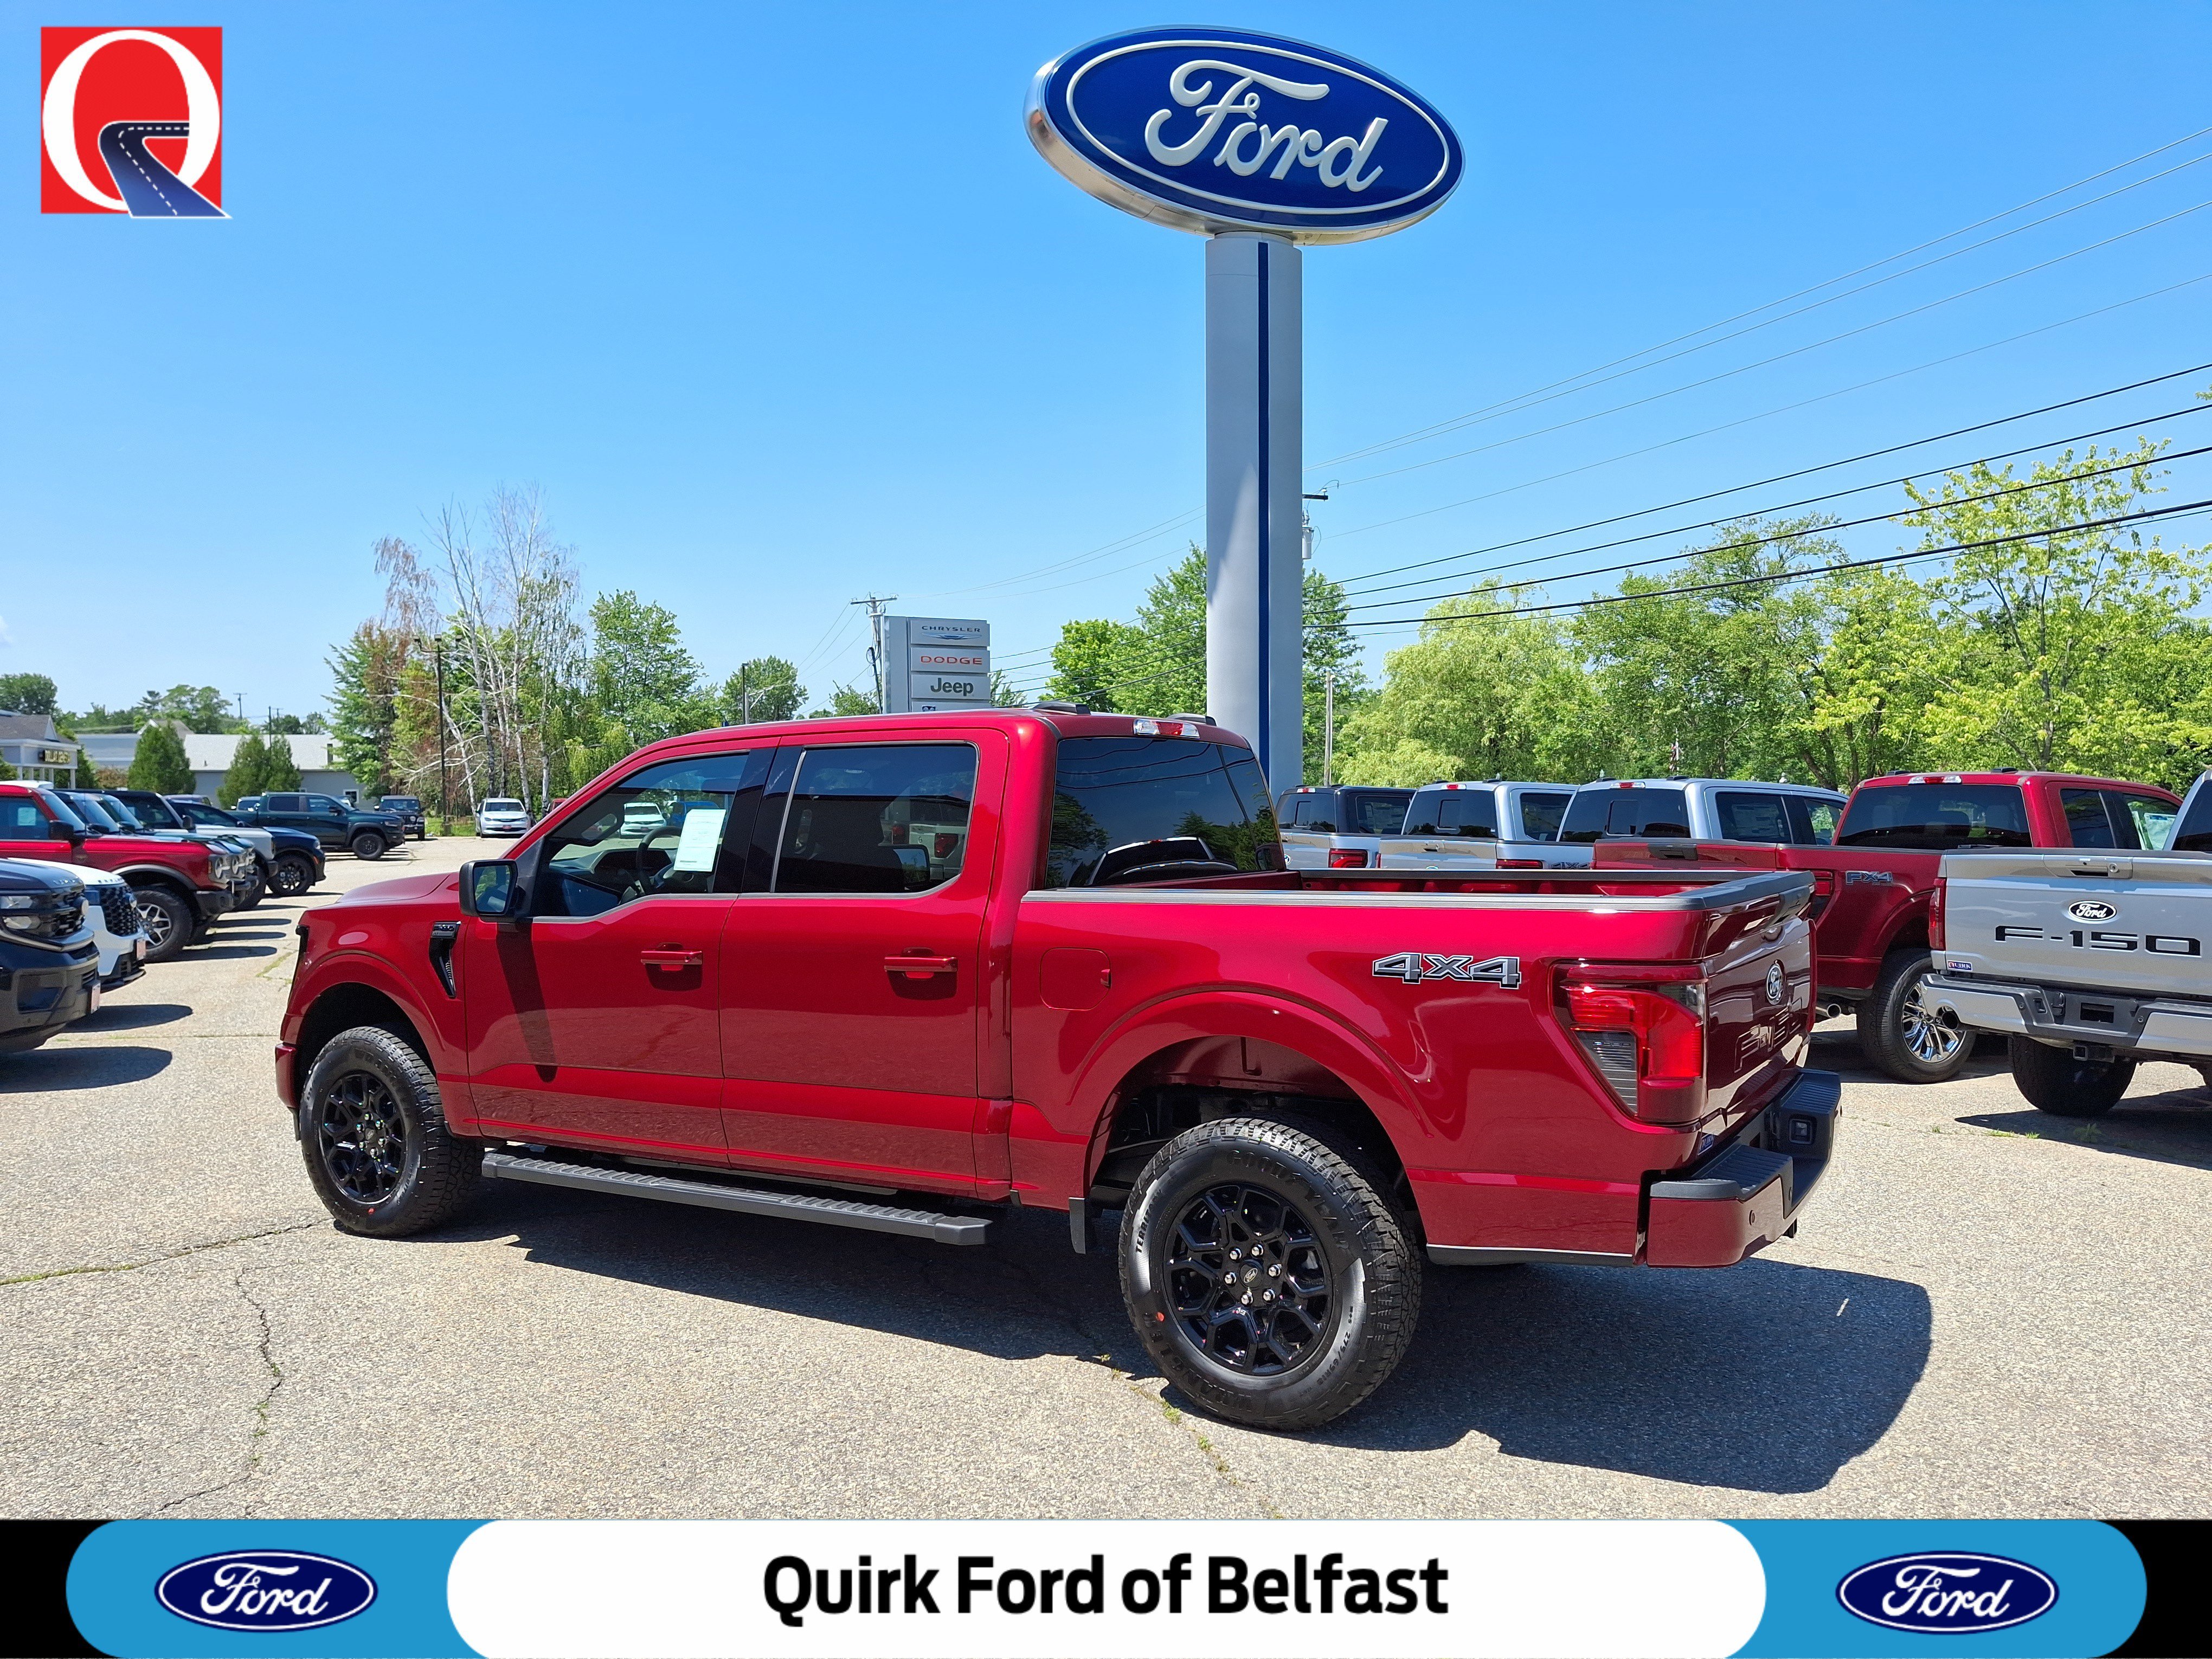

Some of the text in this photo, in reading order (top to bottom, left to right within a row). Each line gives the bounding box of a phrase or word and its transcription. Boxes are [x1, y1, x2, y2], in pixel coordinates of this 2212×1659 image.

[1144, 59, 1388, 192] Ford
[921, 656, 983, 665] DODGE
[930, 678, 974, 697] Jeep
[1846, 871, 1893, 885] FX4
[2076, 903, 2107, 918] Ford
[1995, 925, 2202, 957] F-150
[1372, 952, 1521, 989] 4X4
